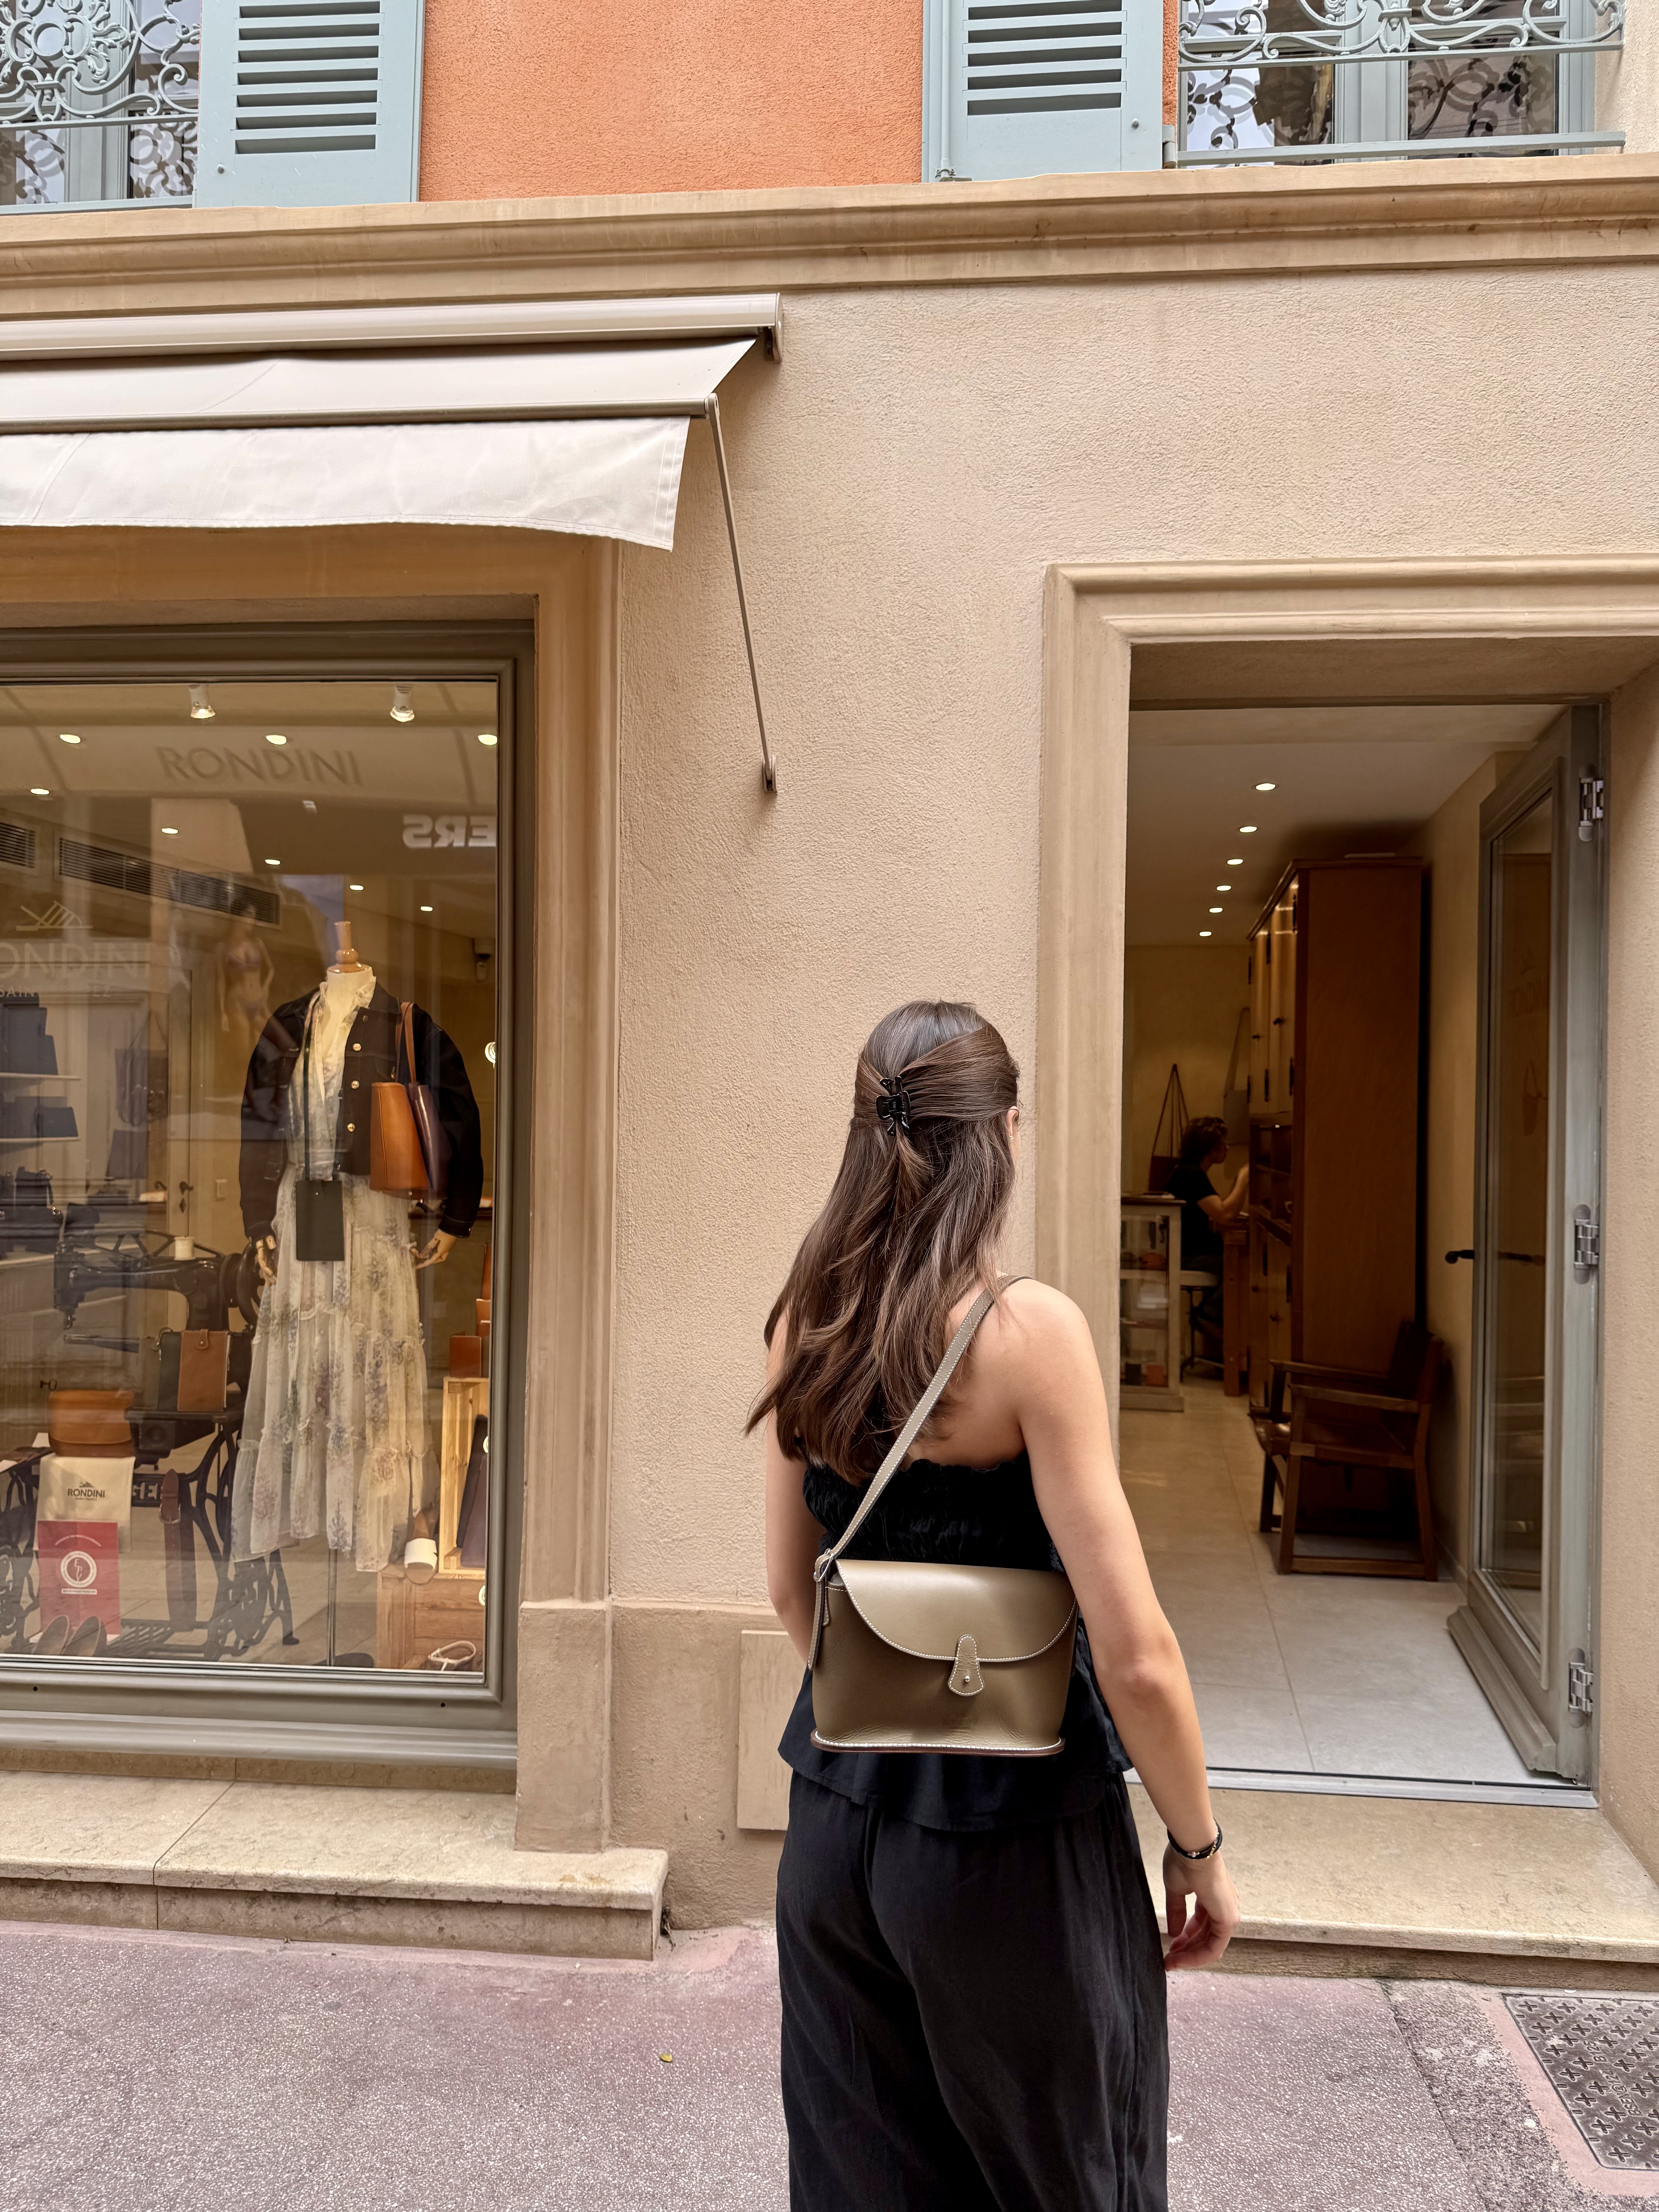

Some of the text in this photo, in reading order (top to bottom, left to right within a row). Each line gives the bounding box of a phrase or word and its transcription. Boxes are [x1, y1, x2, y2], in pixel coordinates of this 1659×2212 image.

[156, 746, 364, 787] RONDINI
[0, 942, 152, 979] ONDINI
[68, 1488, 105, 1498] RONDINI
[1583, 2041, 1608, 2062] B125
